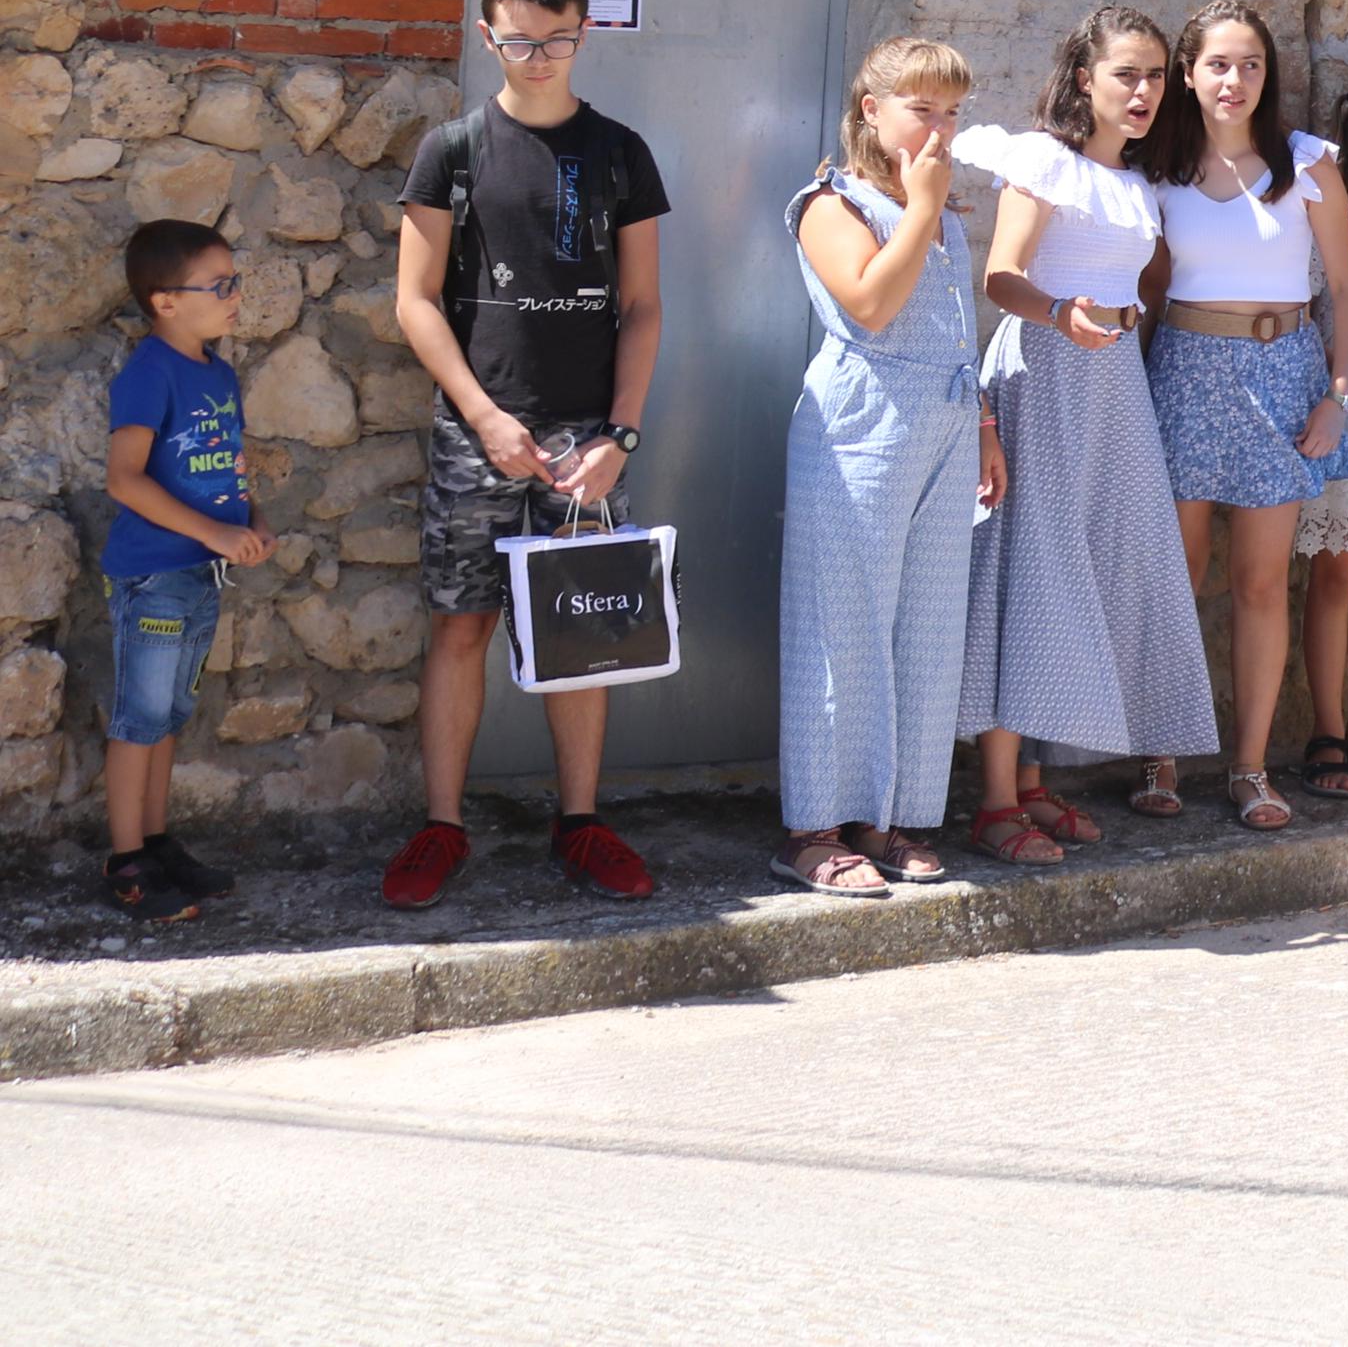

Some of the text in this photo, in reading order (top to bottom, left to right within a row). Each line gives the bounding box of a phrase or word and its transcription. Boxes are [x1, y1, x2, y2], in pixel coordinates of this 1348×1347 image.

[200, 419, 220, 433] I'M
[222, 430, 229, 441] A
[190, 451, 233, 473] NICE
[571, 592, 630, 615] Sfera
